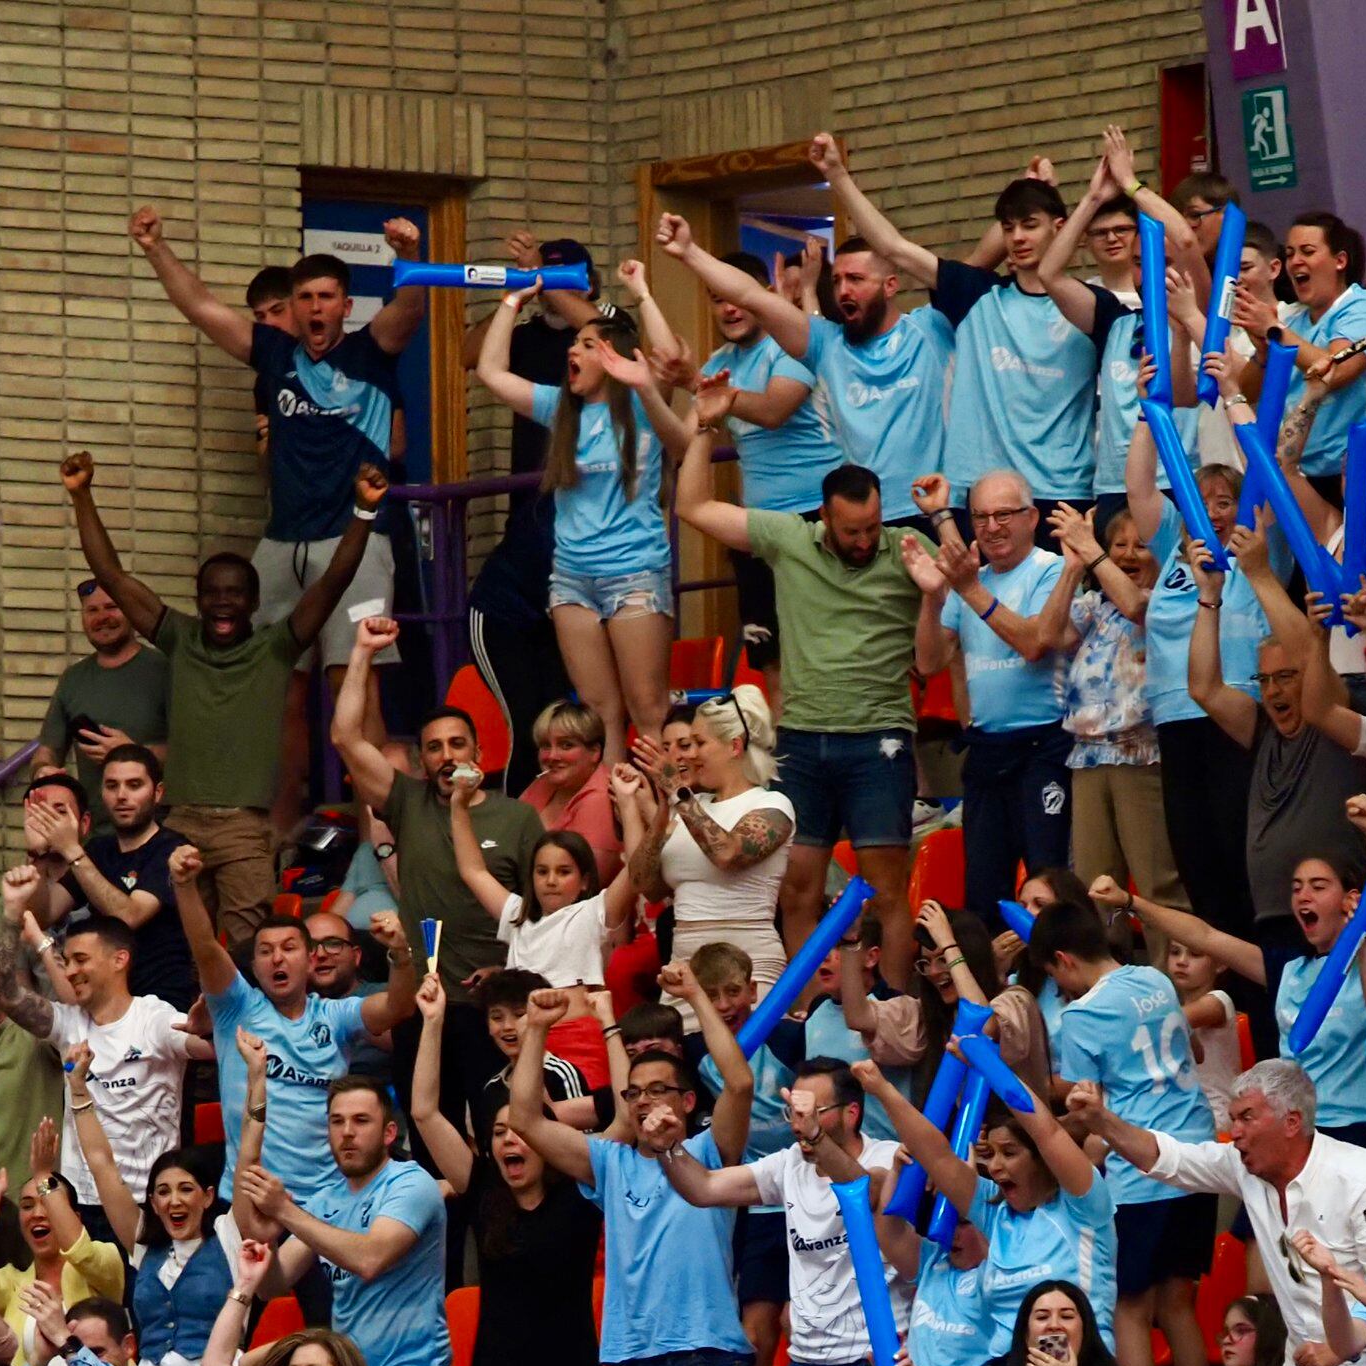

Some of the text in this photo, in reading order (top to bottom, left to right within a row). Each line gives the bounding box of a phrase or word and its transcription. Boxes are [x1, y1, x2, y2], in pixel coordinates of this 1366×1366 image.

[1234, 0, 1278, 51] A
[1131, 1011, 1191, 1095] 10
[283, 1065, 333, 1088] Avanz
[798, 1231, 849, 1252] Avanza
[993, 1263, 1052, 1286] Avanza
